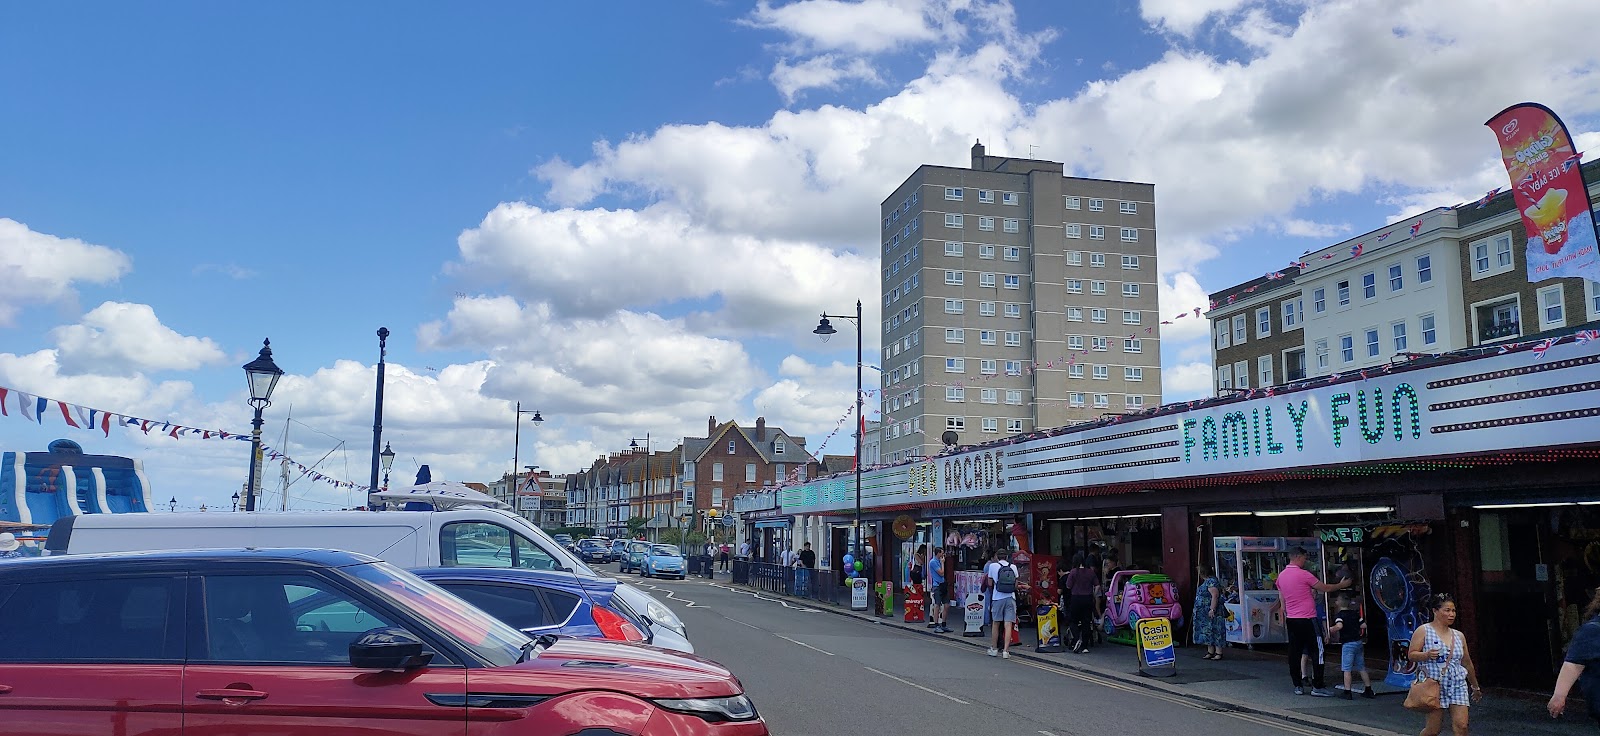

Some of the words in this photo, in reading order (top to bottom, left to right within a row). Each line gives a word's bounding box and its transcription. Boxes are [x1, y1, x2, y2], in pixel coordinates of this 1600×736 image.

[1182, 399, 1309, 463] FAMILY
[1330, 382, 1422, 449] FUN
[908, 462, 938, 497] PIER
[944, 449, 1006, 494] ARCADE
[1142, 623, 1168, 635] Cash
[1143, 633, 1169, 642] Machine
